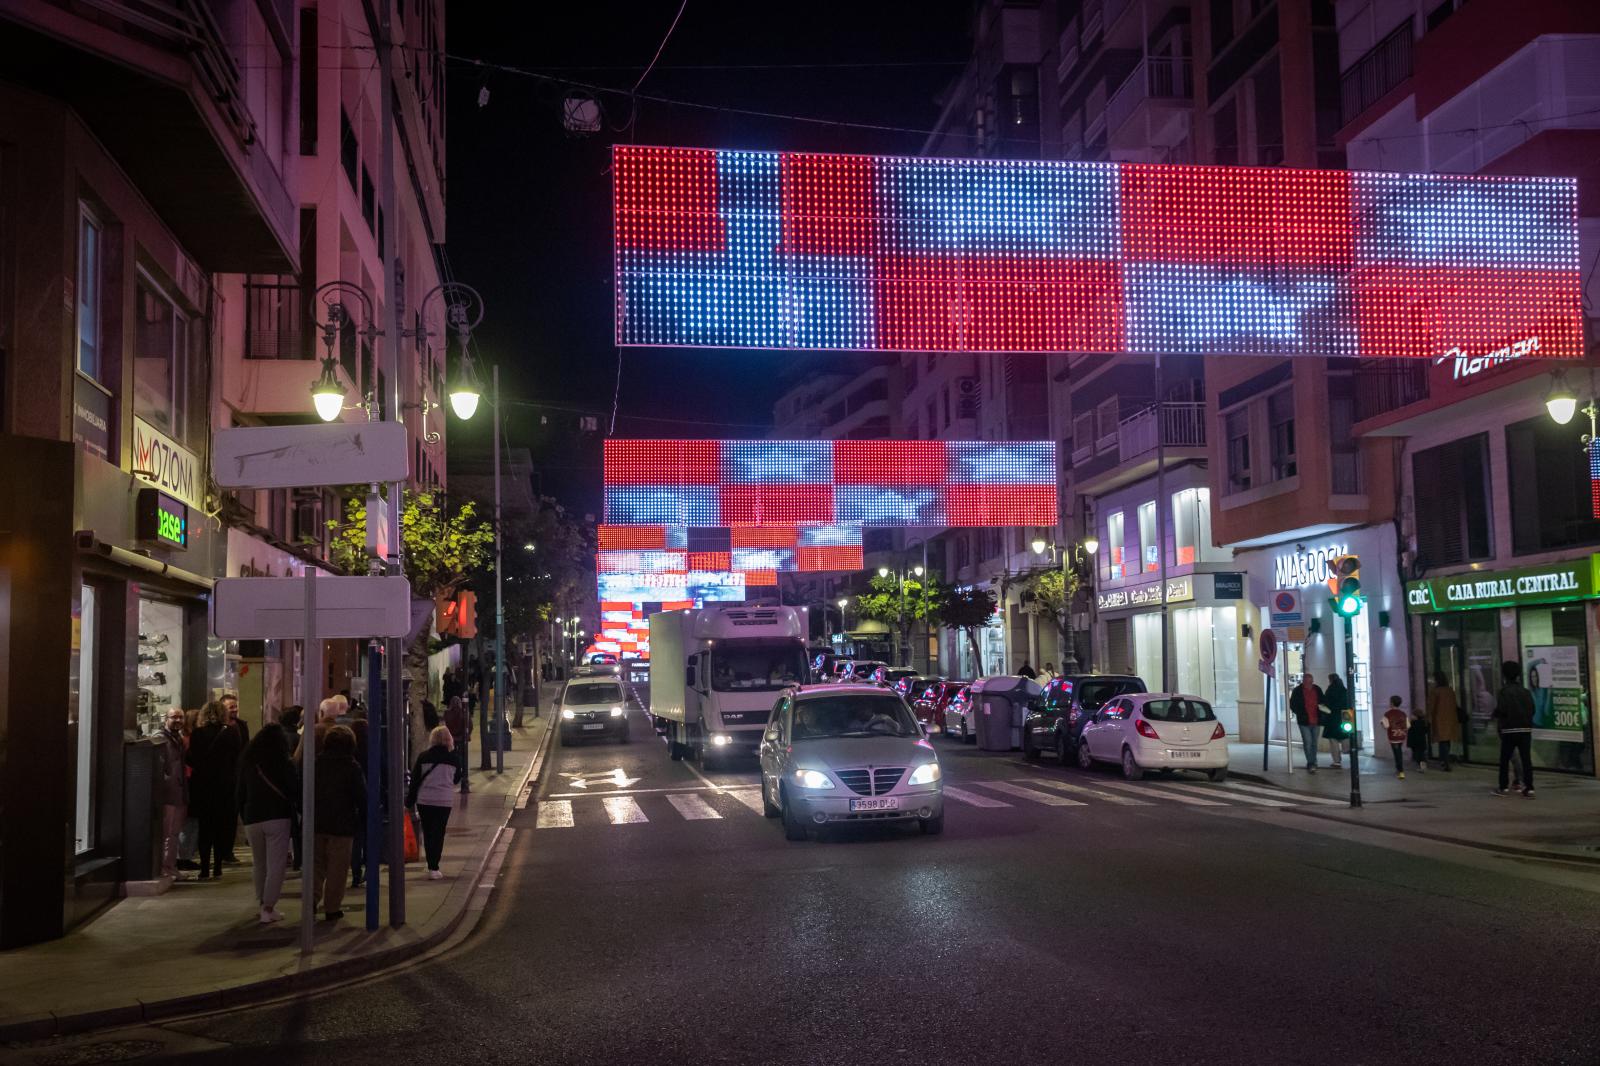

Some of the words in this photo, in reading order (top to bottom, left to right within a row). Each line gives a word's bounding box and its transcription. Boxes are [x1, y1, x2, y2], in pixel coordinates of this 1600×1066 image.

[1436, 335, 1542, 380] Norman
[1408, 588, 1430, 605] CRC
[1447, 584, 1475, 601] CAJA
[1475, 579, 1516, 599] RURAL
[1516, 572, 1579, 594] CENTRAL
[1554, 711, 1580, 727] 300€
